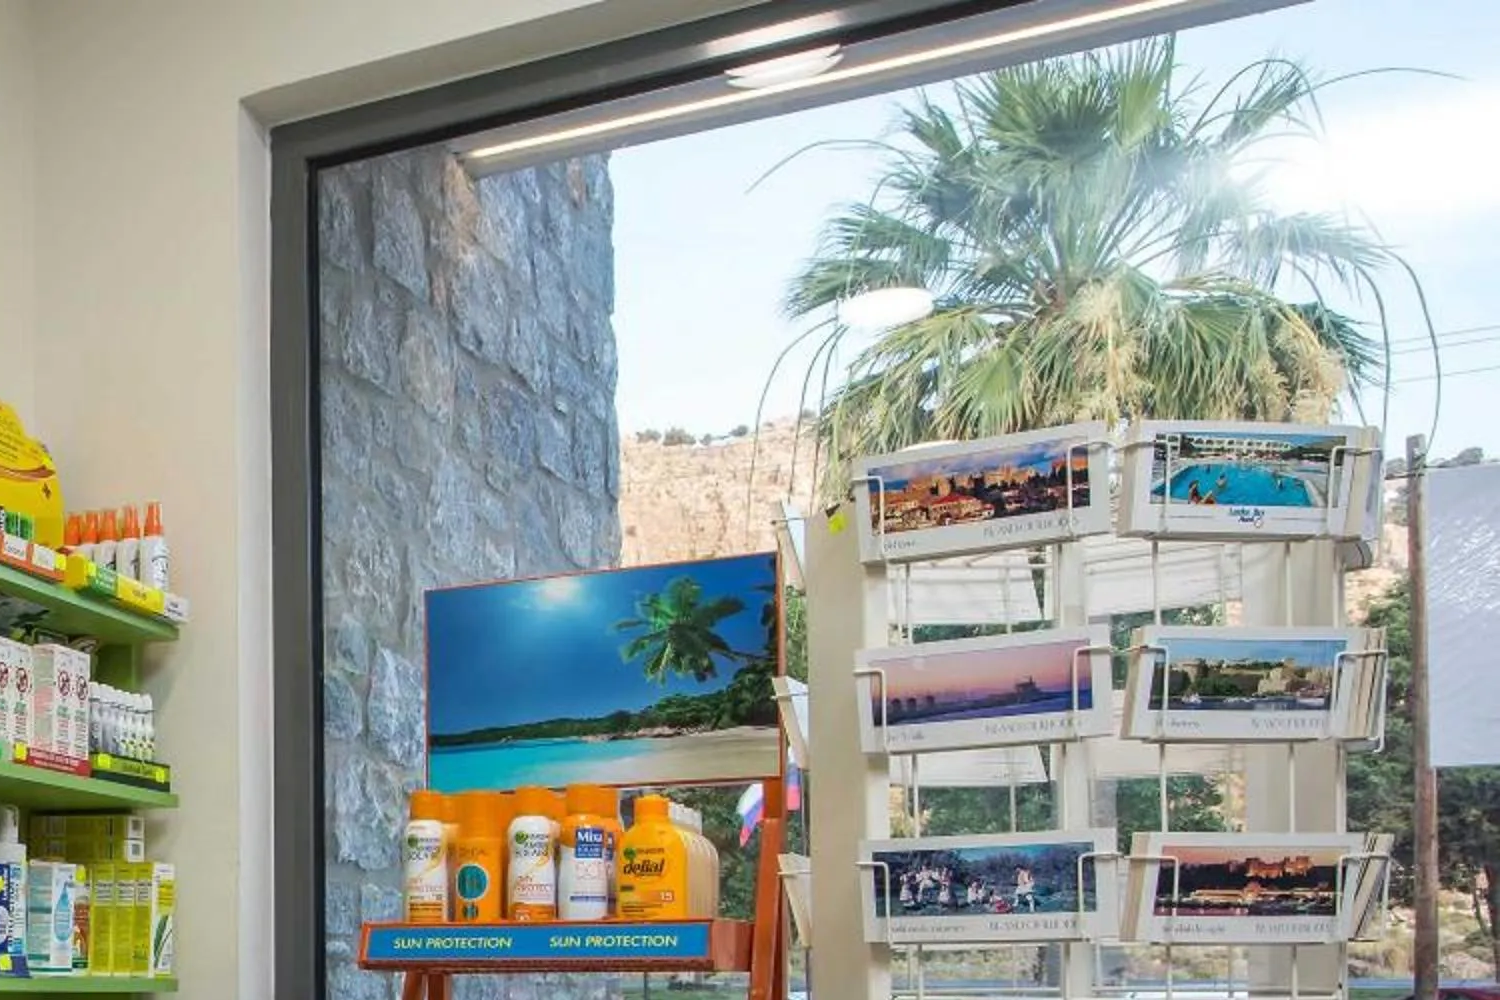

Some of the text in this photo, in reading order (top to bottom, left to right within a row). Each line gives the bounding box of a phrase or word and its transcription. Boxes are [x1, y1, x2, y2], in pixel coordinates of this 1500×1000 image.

[622, 858, 665, 878] delial
[659, 892, 673, 902] 15
[393, 937, 512, 949] SUN PROTECTION
[549, 935, 678, 948] SUN PROTECTION
